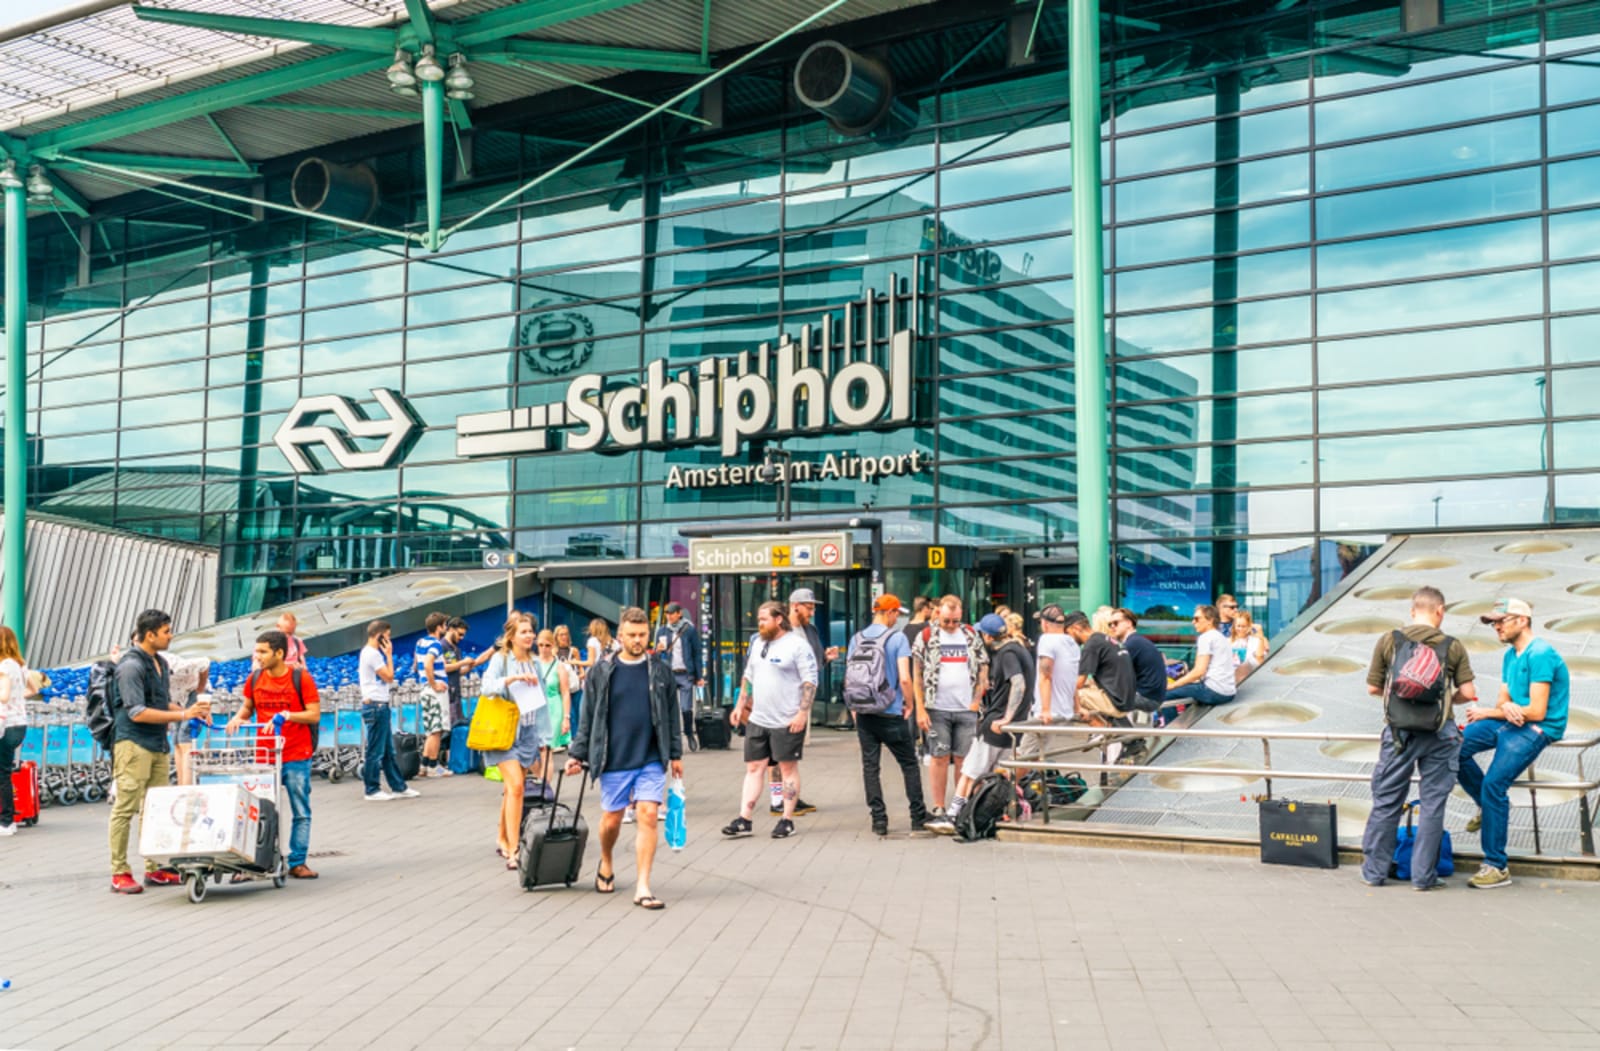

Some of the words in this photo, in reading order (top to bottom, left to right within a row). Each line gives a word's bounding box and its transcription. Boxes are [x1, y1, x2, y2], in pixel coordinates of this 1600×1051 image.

[566, 329, 912, 456] Schiphol
[820, 450, 921, 482] Airport
[696, 546, 769, 569] Schiphol
[931, 549, 942, 566] D
[1269, 832, 1318, 843] CAVALLARO
